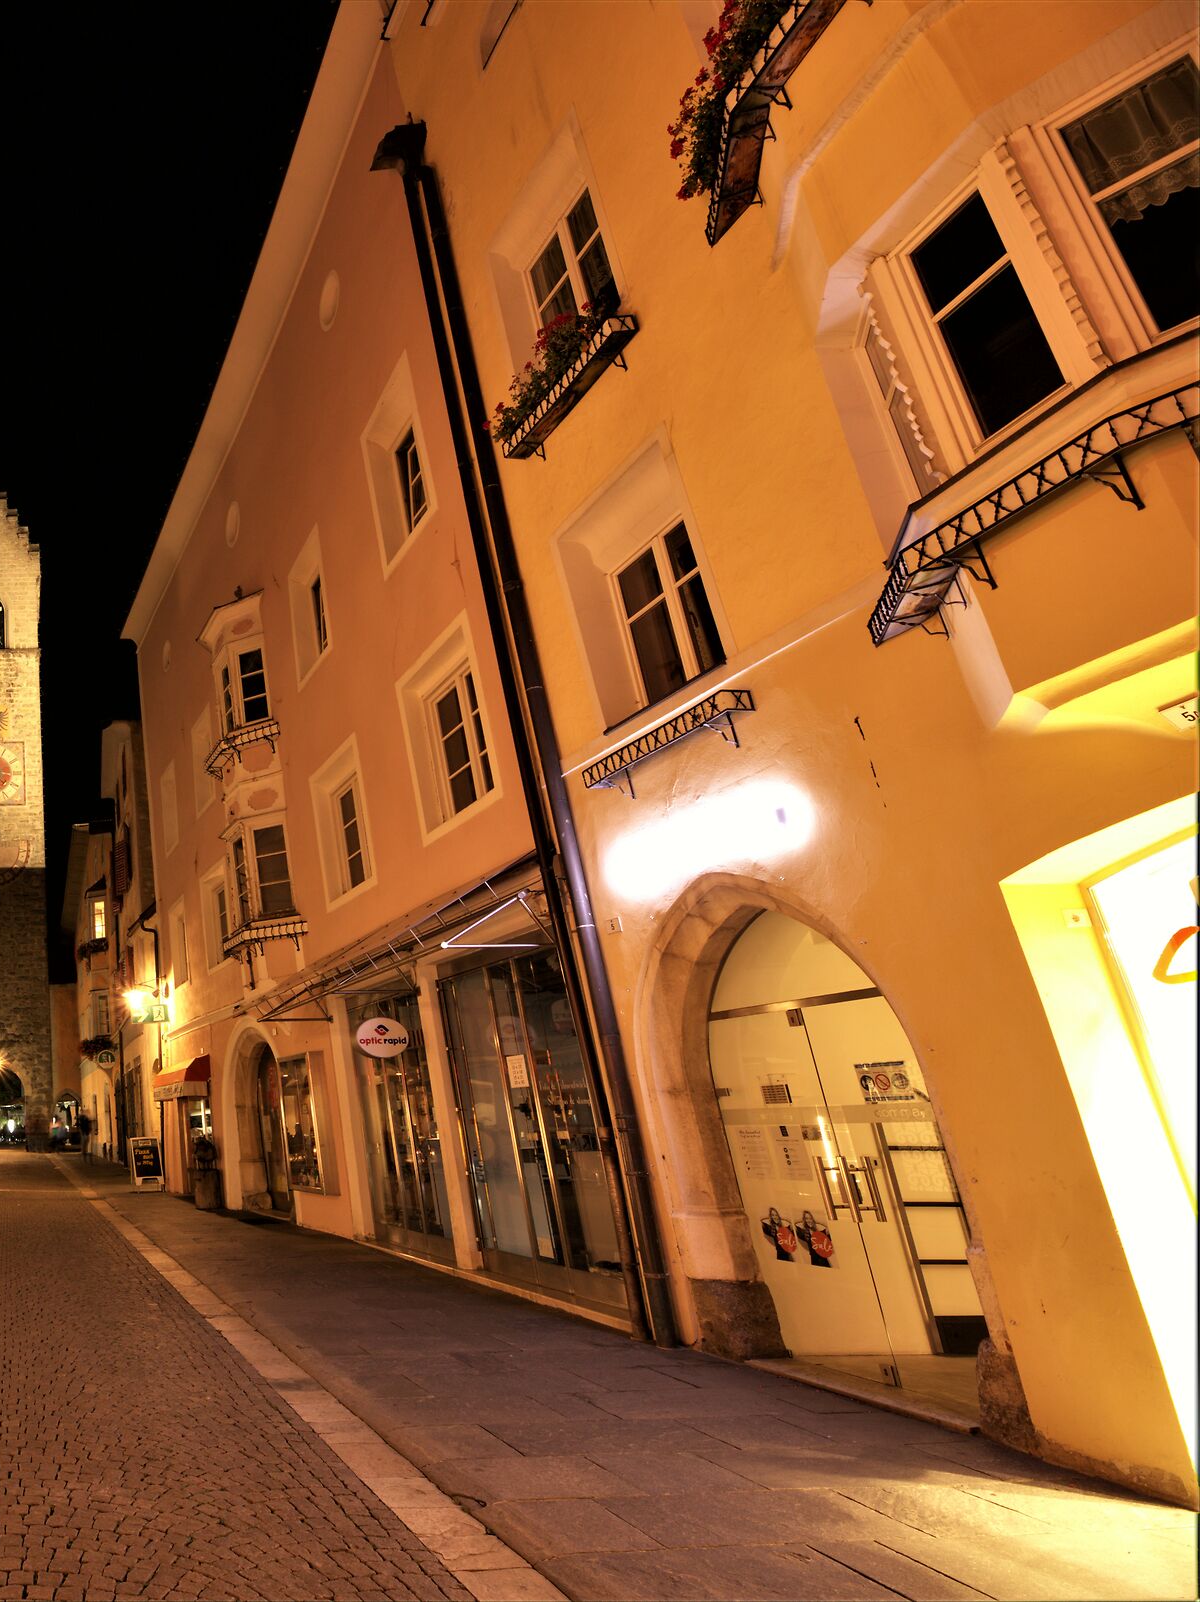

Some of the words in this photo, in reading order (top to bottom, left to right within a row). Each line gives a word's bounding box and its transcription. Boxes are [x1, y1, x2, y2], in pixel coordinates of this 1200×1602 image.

[610, 923, 616, 931] 5
[359, 1037, 383, 1046] optic
[383, 1037, 407, 1046] rapid
